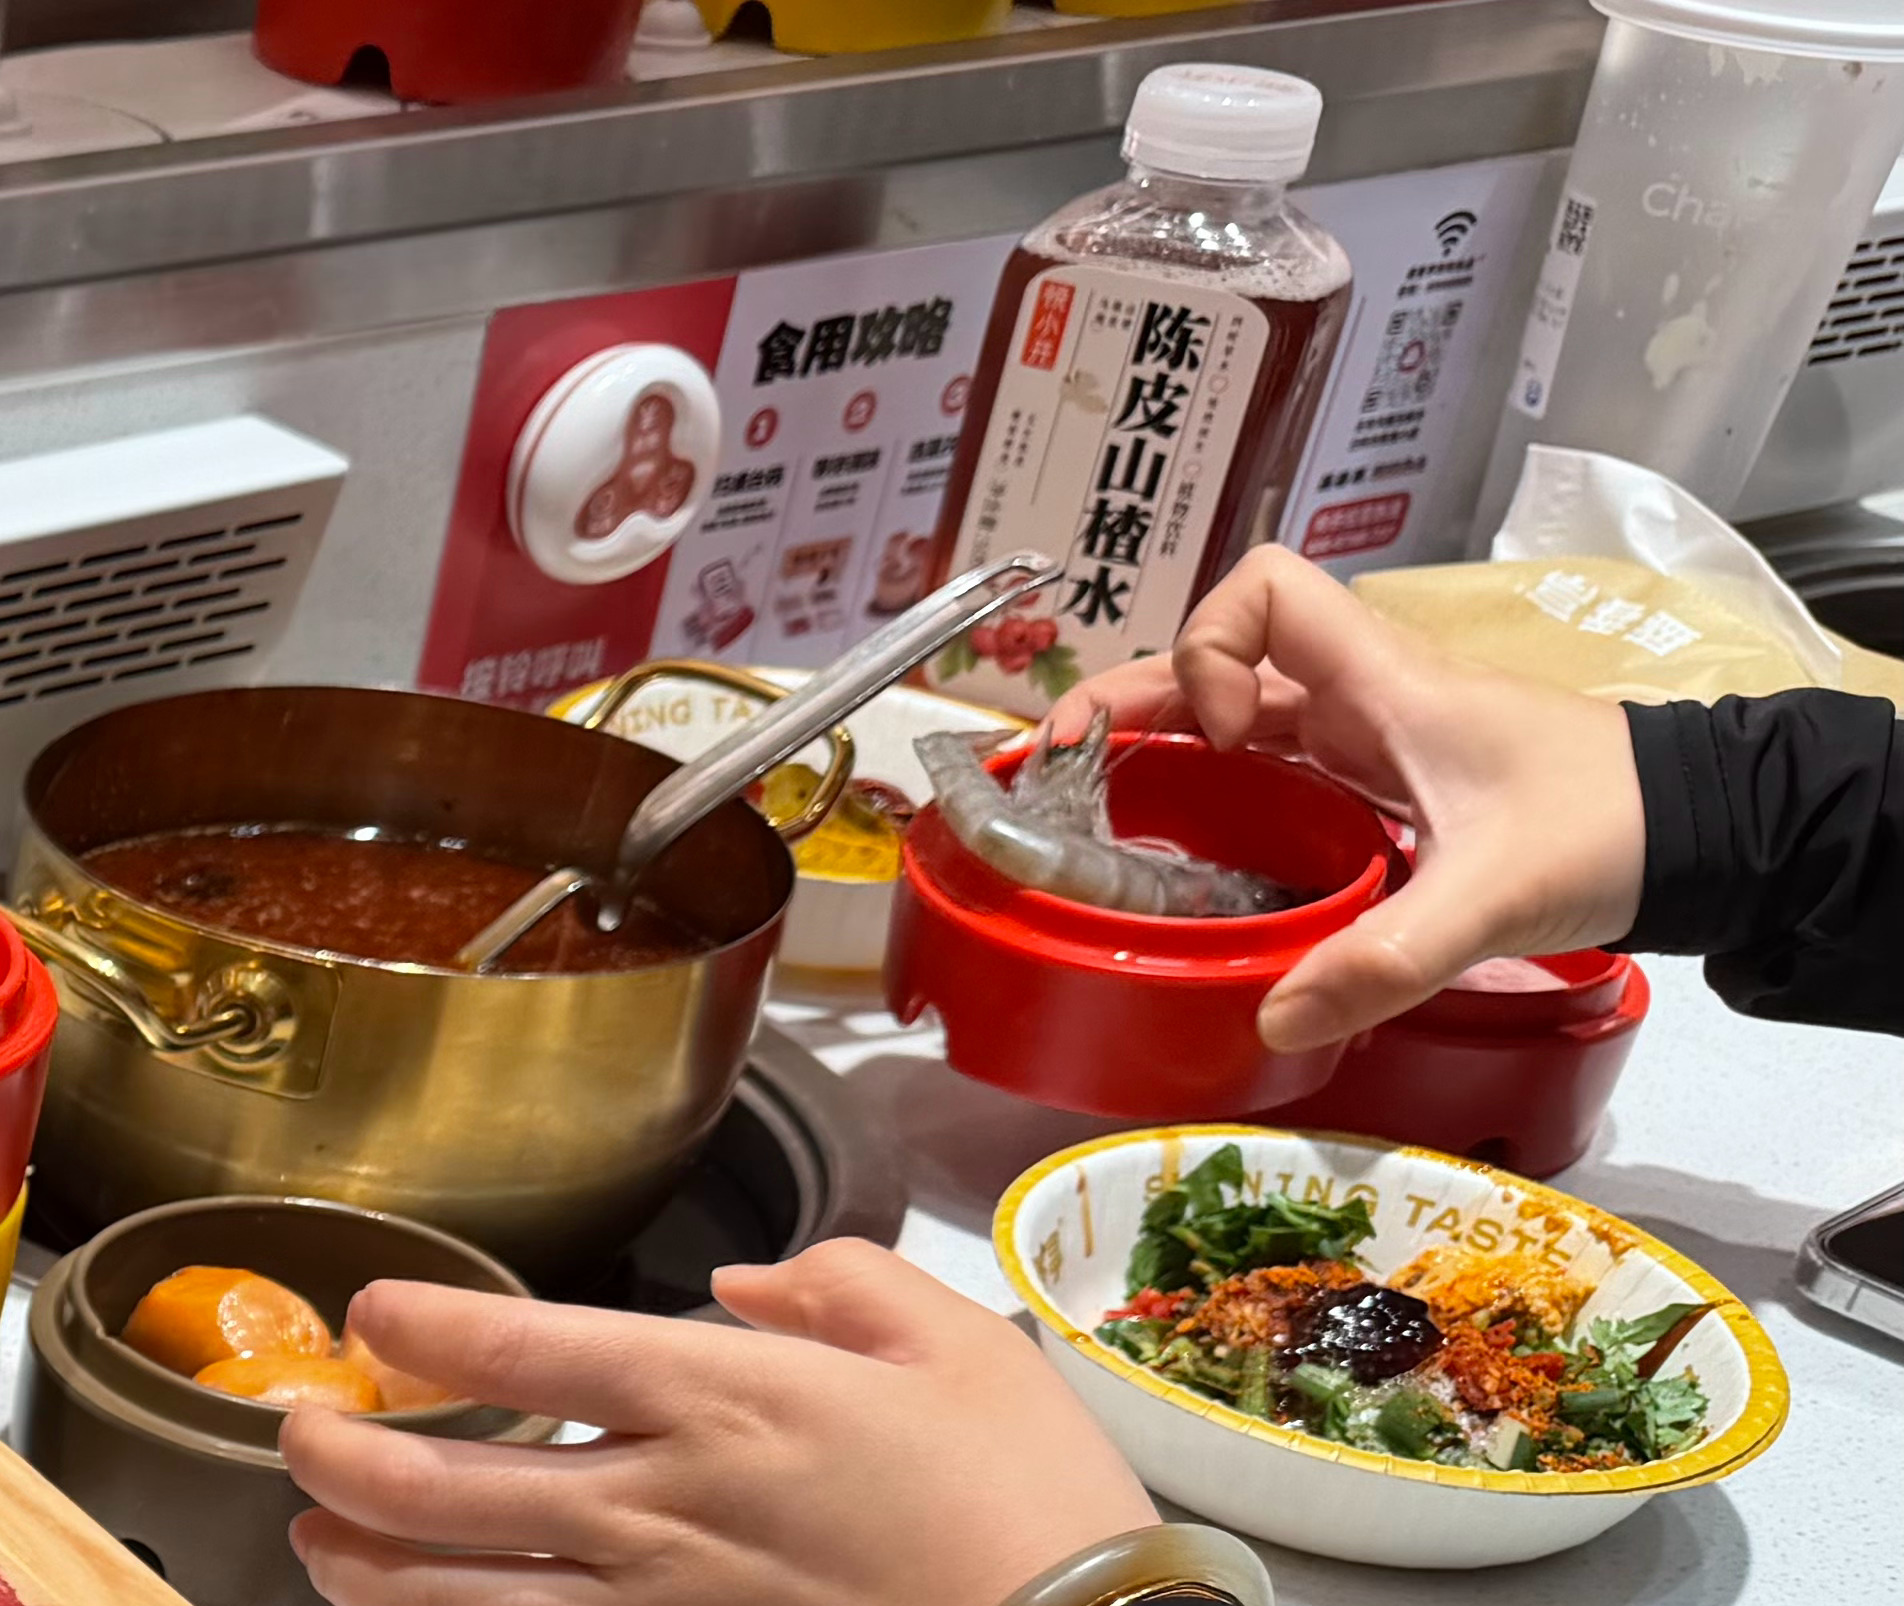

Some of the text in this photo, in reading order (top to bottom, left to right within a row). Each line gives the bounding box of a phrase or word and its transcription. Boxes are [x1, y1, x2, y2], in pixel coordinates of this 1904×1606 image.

[753, 298, 954, 385] 食用攻略
[1062, 299, 1212, 627] 陈皮山楂水
[1404, 1194, 1576, 1270] TASTE
